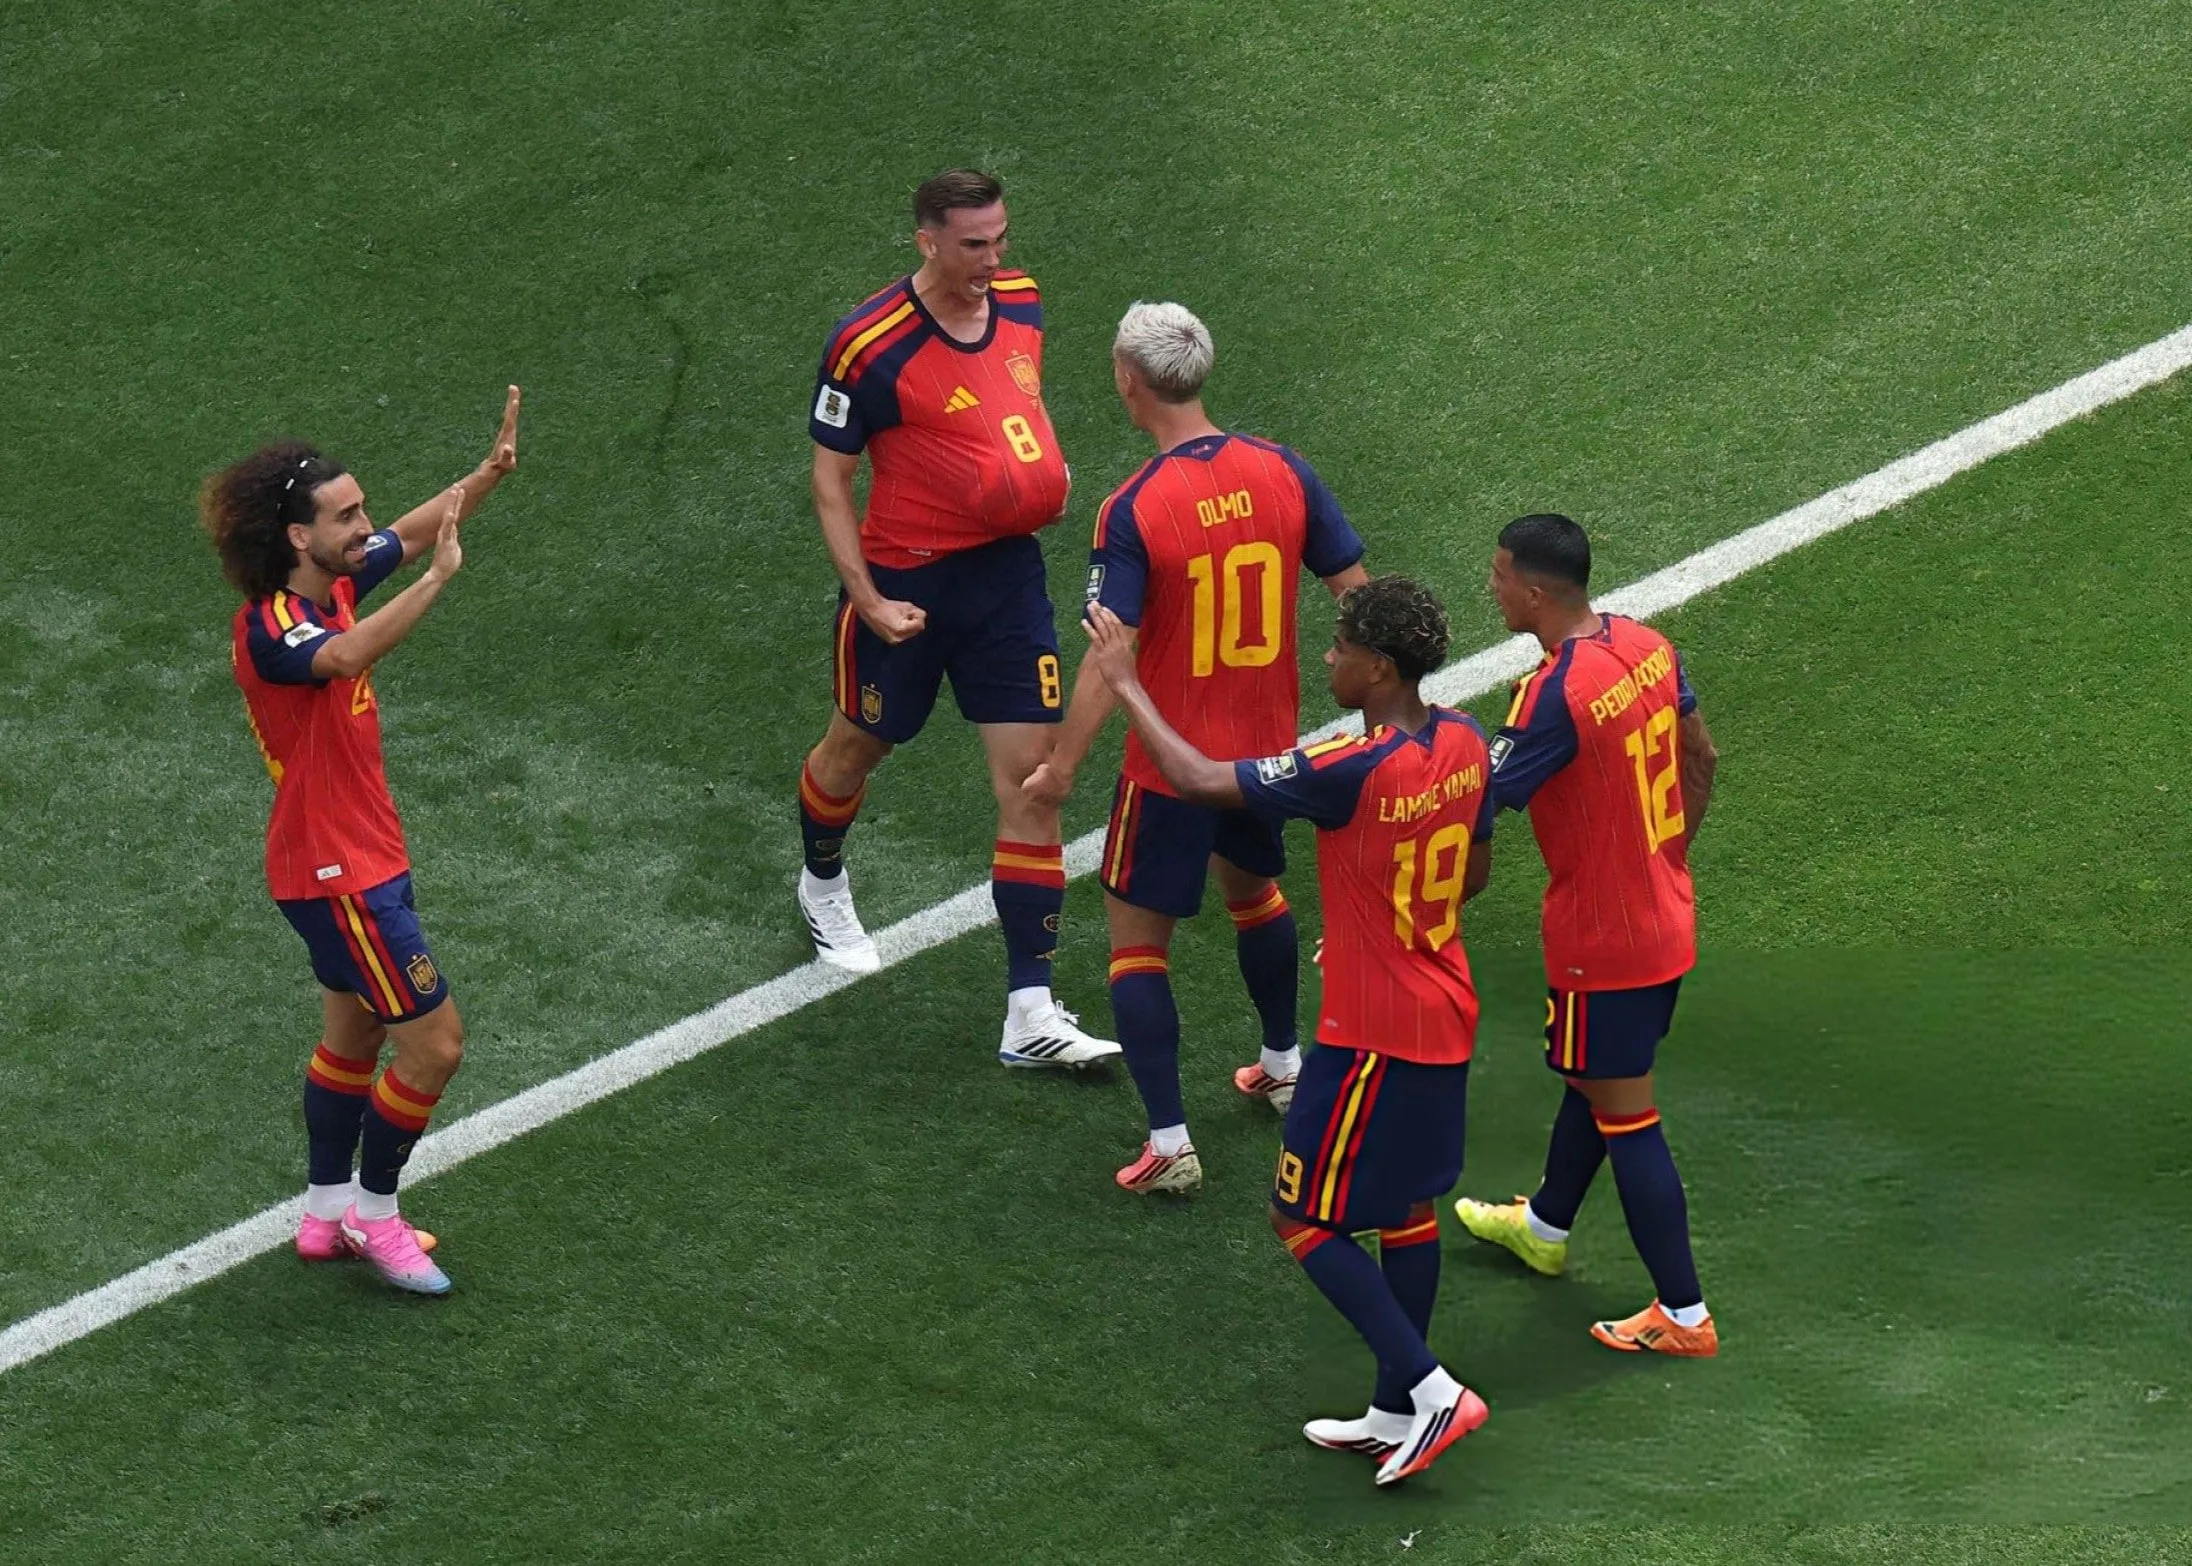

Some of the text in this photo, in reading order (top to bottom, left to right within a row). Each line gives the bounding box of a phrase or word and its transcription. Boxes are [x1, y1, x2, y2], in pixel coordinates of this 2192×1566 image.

[1002, 415, 1043, 462] 8
[1196, 490, 1253, 528] OLMO
[1187, 541, 1282, 678] 10
[1038, 654, 1061, 708] 8
[1624, 705, 1686, 855] 12
[1393, 823, 1470, 952] 19
[1275, 1142, 1303, 1204] 9
